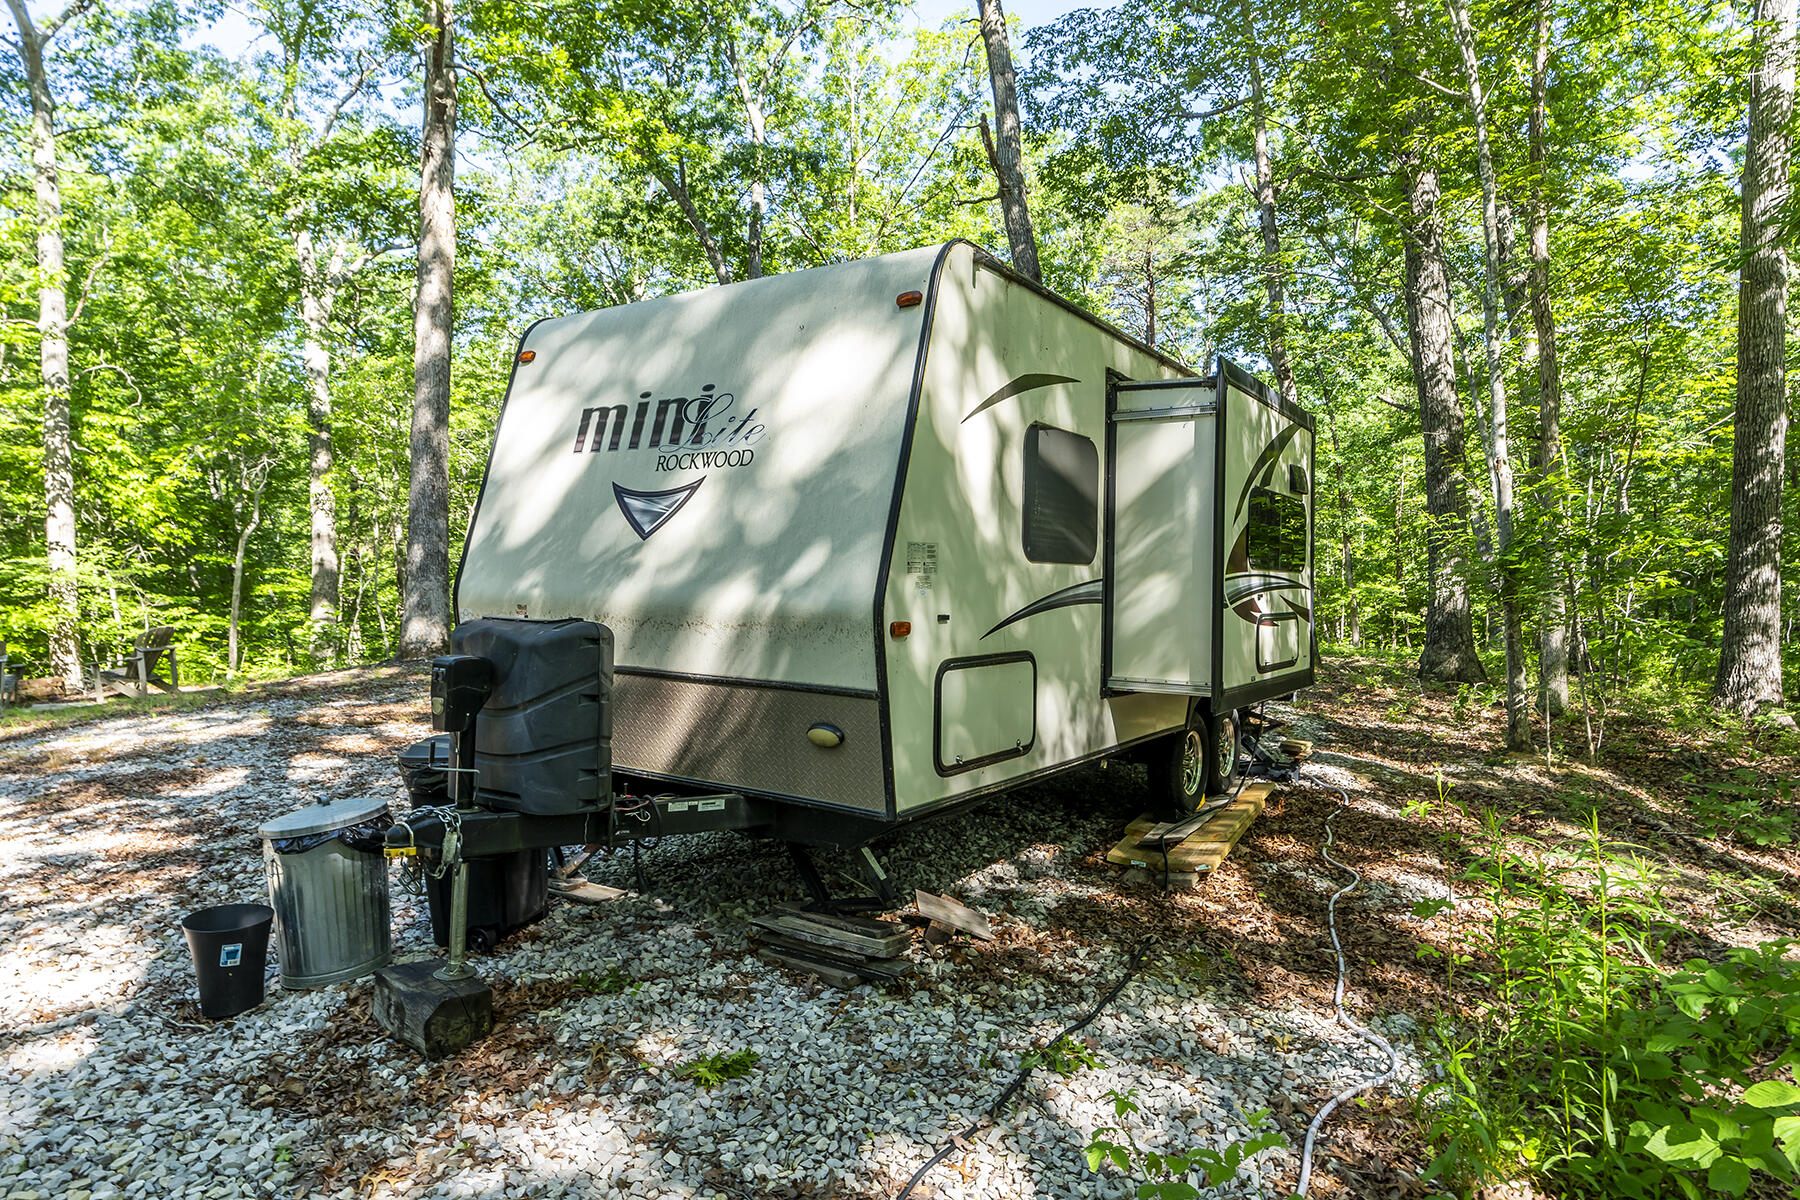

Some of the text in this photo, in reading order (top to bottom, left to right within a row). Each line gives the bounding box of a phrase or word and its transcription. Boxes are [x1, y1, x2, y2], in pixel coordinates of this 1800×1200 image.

[573, 383, 767, 454] mini Lite
[655, 449, 754, 472] ROCKWOOD
